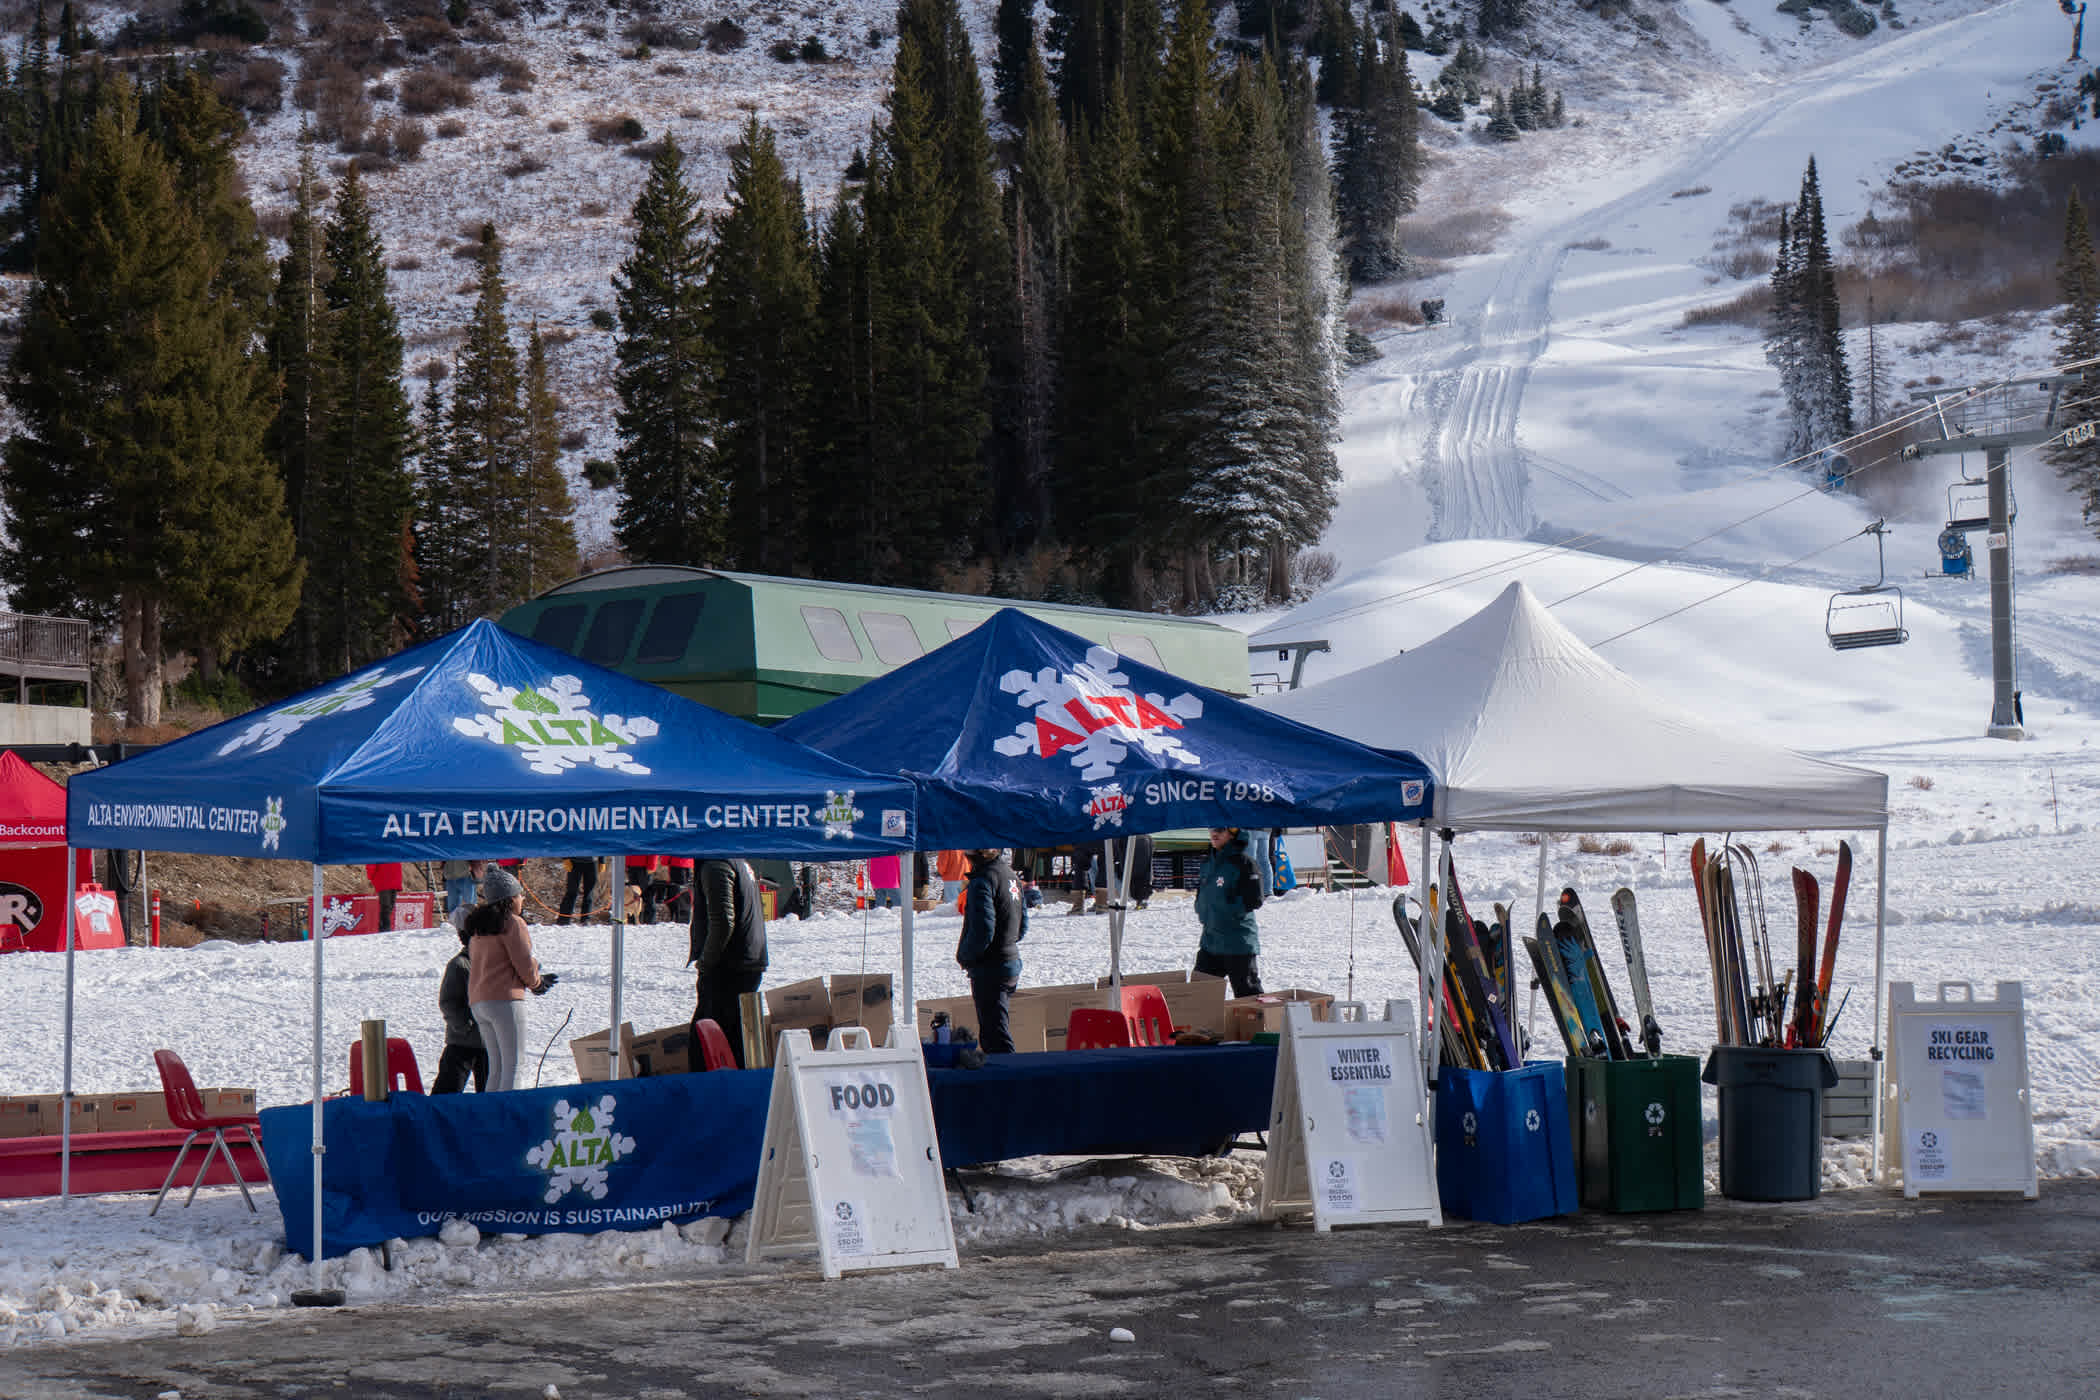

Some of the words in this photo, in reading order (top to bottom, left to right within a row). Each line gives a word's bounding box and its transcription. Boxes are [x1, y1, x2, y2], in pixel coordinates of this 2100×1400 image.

[503, 716, 630, 746] ALTA
[1035, 693, 1185, 760] ALTA
[1145, 780, 1217, 805] SINCE
[1223, 781, 1275, 802] 1938
[824, 808, 854, 822] ALTA
[1089, 795, 1127, 816] ALTA
[88, 804, 113, 826] ALTA
[114, 804, 206, 830] ENVIRONMENTAL
[208, 807, 259, 834] CENTER
[382, 812, 455, 838] ALTA
[461, 805, 698, 836] ENVIRONMENTAL
[704, 804, 811, 829] CENTER
[1931, 1030, 1952, 1045] SKI
[1955, 1030, 1989, 1045] GEAR
[1337, 1048, 1381, 1064] WINTER
[1927, 1045, 1995, 1061] RECYCLING
[1330, 1064, 1392, 1081] ESSENTIALS
[830, 1083, 895, 1111] FOOD
[547, 1135, 614, 1169] ALTA
[417, 1210, 457, 1225] OUR
[462, 1209, 541, 1225] MISSION
[543, 1210, 561, 1226] IS
[565, 1200, 714, 1225] SUSTAINABILITY
